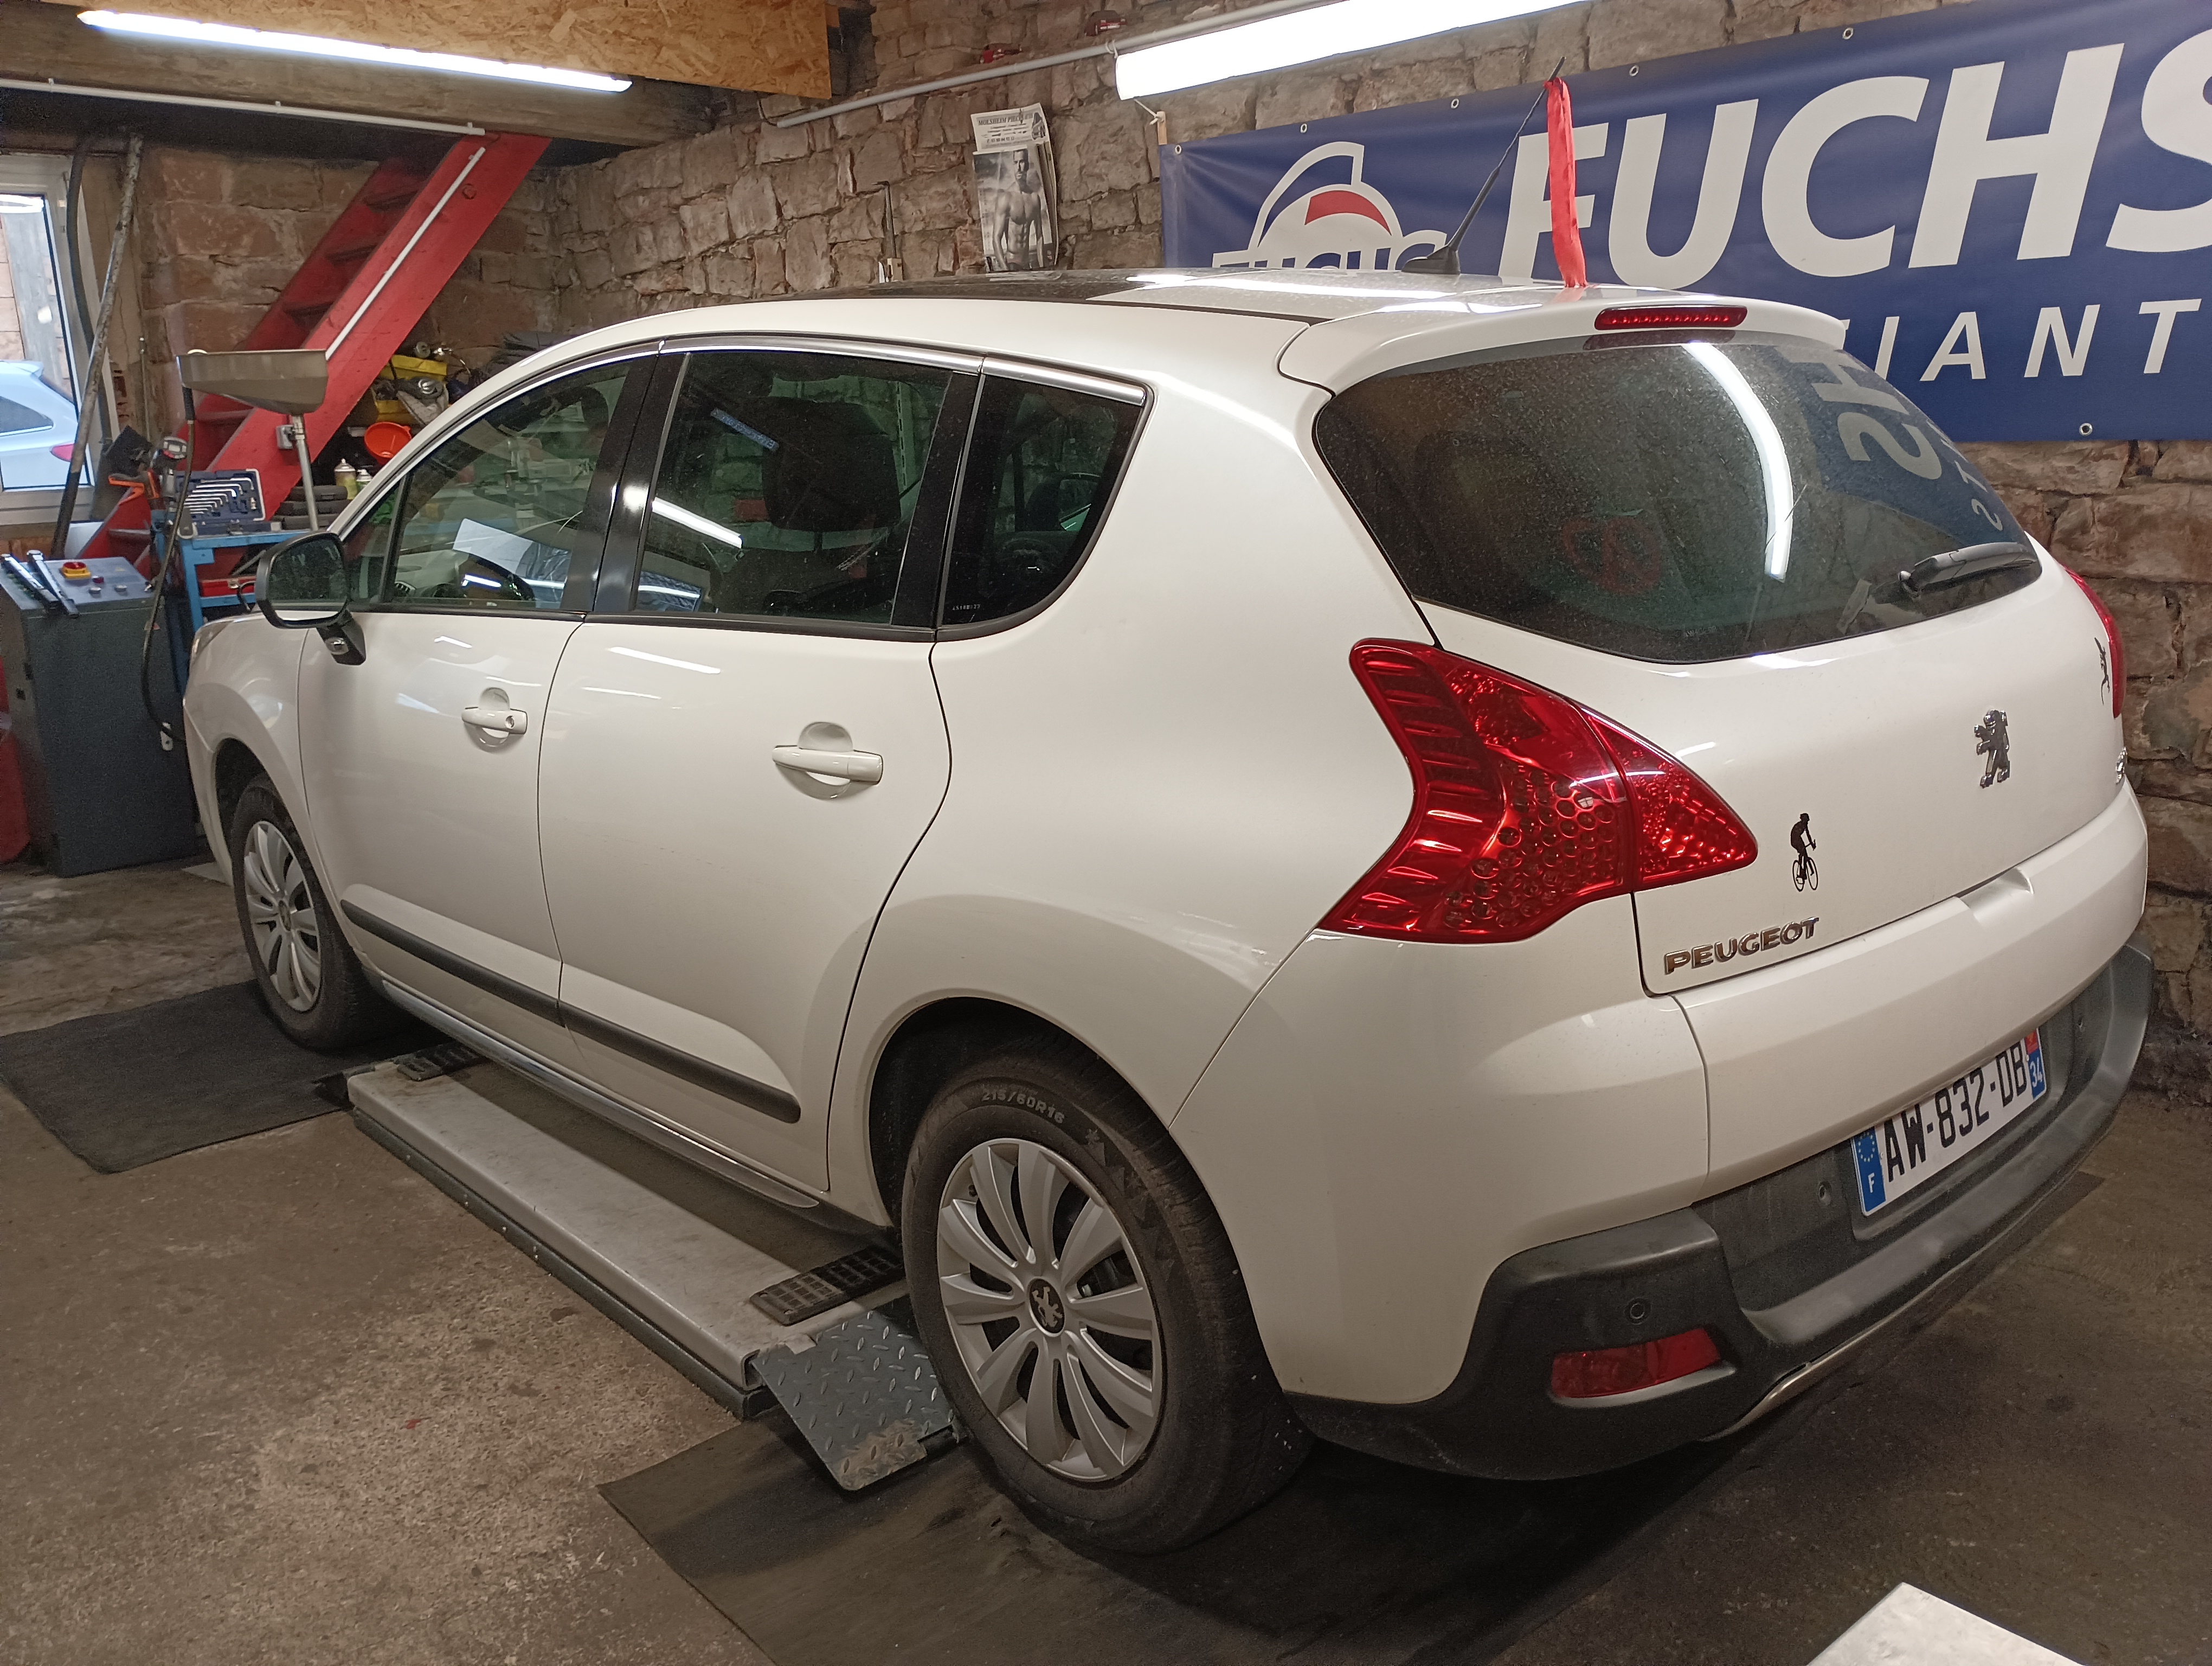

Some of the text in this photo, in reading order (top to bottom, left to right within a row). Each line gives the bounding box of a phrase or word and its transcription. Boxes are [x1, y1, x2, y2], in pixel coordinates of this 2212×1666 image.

[1499, 27, 2212, 290] FUCHS
[1844, 298, 2201, 381] IANT
[1664, 917, 1819, 975] PEUGEOT
[2030, 1057, 2043, 1087] 34
[981, 1089, 1065, 1124] 215/60R16
[1883, 1040, 2028, 1183] AW-832-DB
[1868, 1172, 1875, 1193] F
